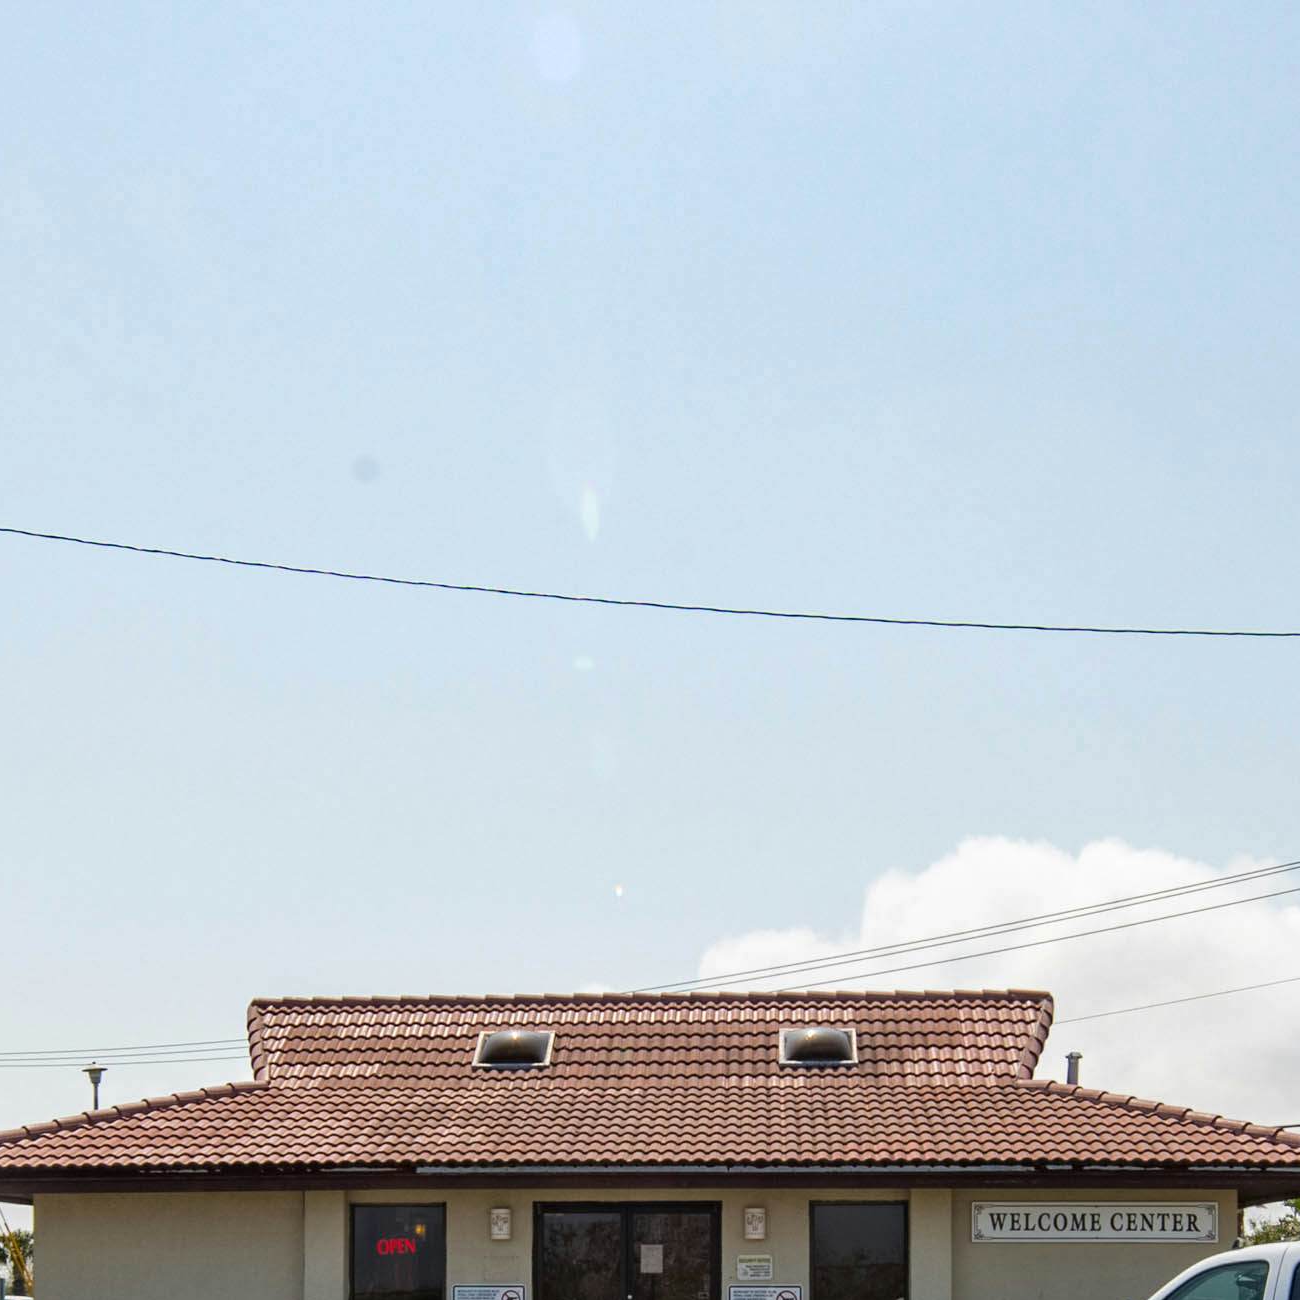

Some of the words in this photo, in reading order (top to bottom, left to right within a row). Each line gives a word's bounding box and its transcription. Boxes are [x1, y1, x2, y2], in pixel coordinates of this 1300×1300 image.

[989, 1212, 1101, 1232] WELCOME
[1109, 1212, 1201, 1232] CENTER
[376, 1238, 416, 1256] OPEN
